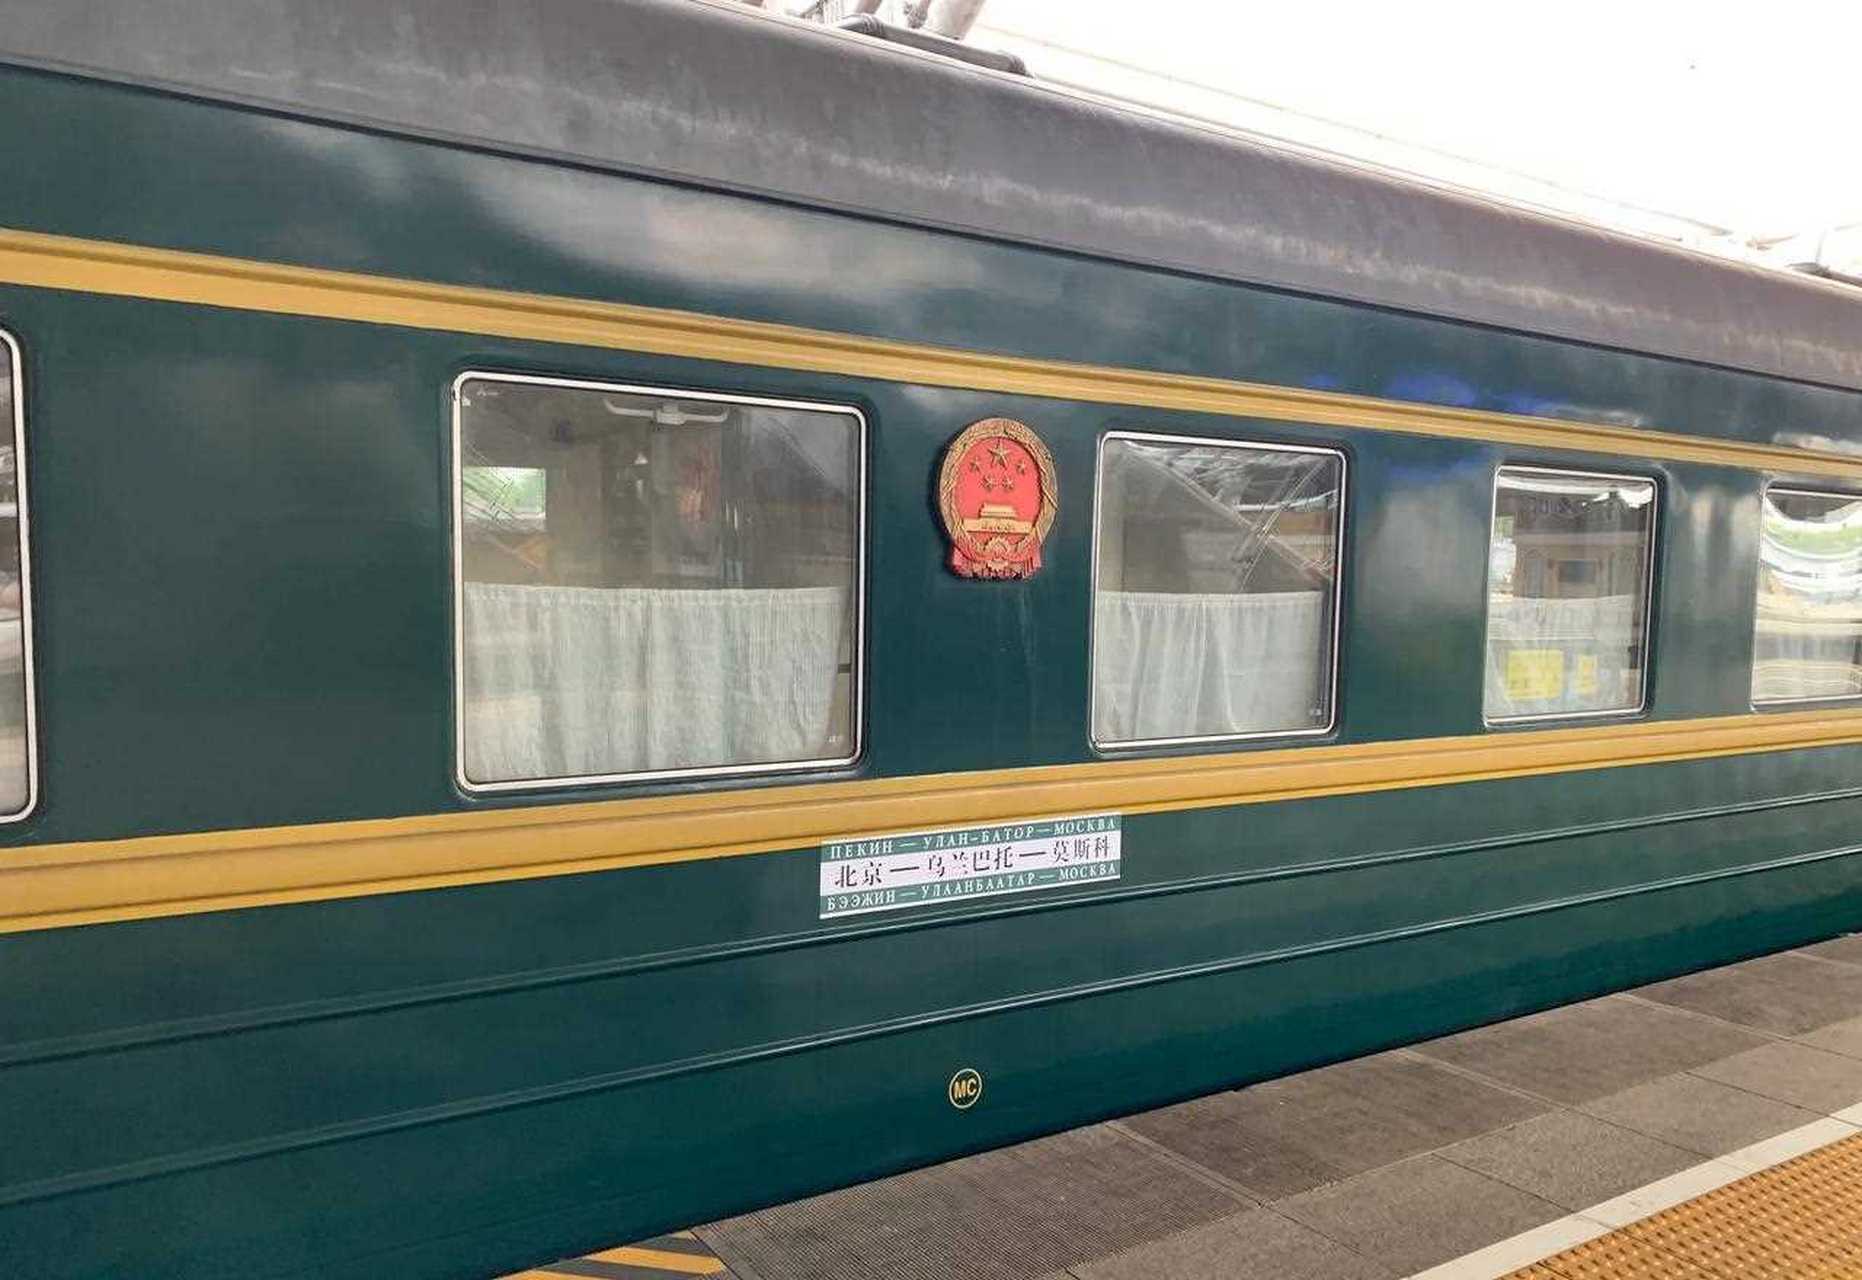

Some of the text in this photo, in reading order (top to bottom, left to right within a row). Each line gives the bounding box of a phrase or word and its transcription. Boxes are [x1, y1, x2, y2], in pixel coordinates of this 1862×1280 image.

[831, 818, 1116, 860] ПЕКИН УЛАН-БАТОР МОСКВА
[827, 890, 896, 911] БЭЭЖИН
[1058, 864, 1117, 881] МОСКВА
[835, 862, 882, 888] 北京
